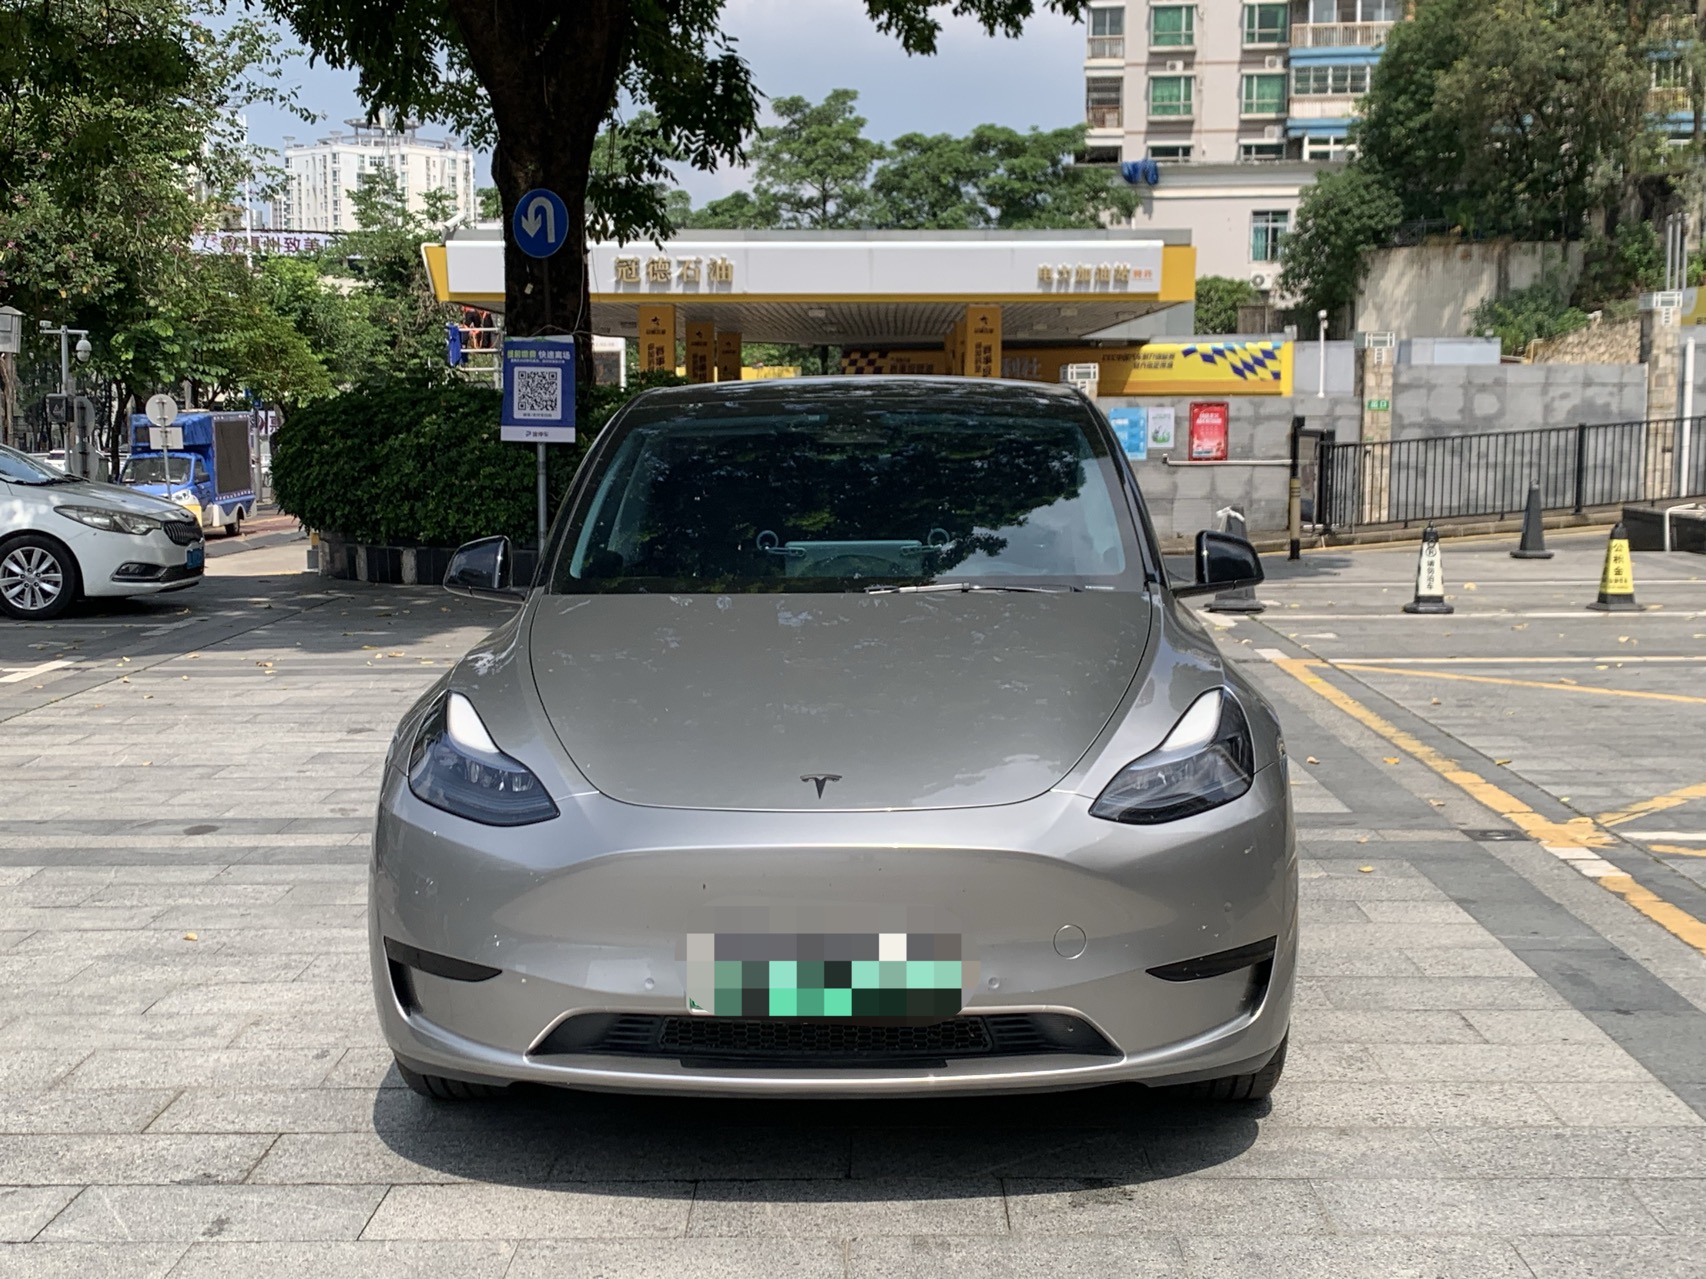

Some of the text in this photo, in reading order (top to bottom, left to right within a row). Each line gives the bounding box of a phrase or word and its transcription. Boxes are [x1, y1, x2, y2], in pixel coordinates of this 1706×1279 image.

[614, 256, 735, 283] 冠德石油
[1037, 261, 1131, 282] 电力加油站
[538, 350, 571, 360] 快速离场
[1613, 543, 1624, 576] 公积金
[1426, 559, 1435, 590] 请勿泊车
